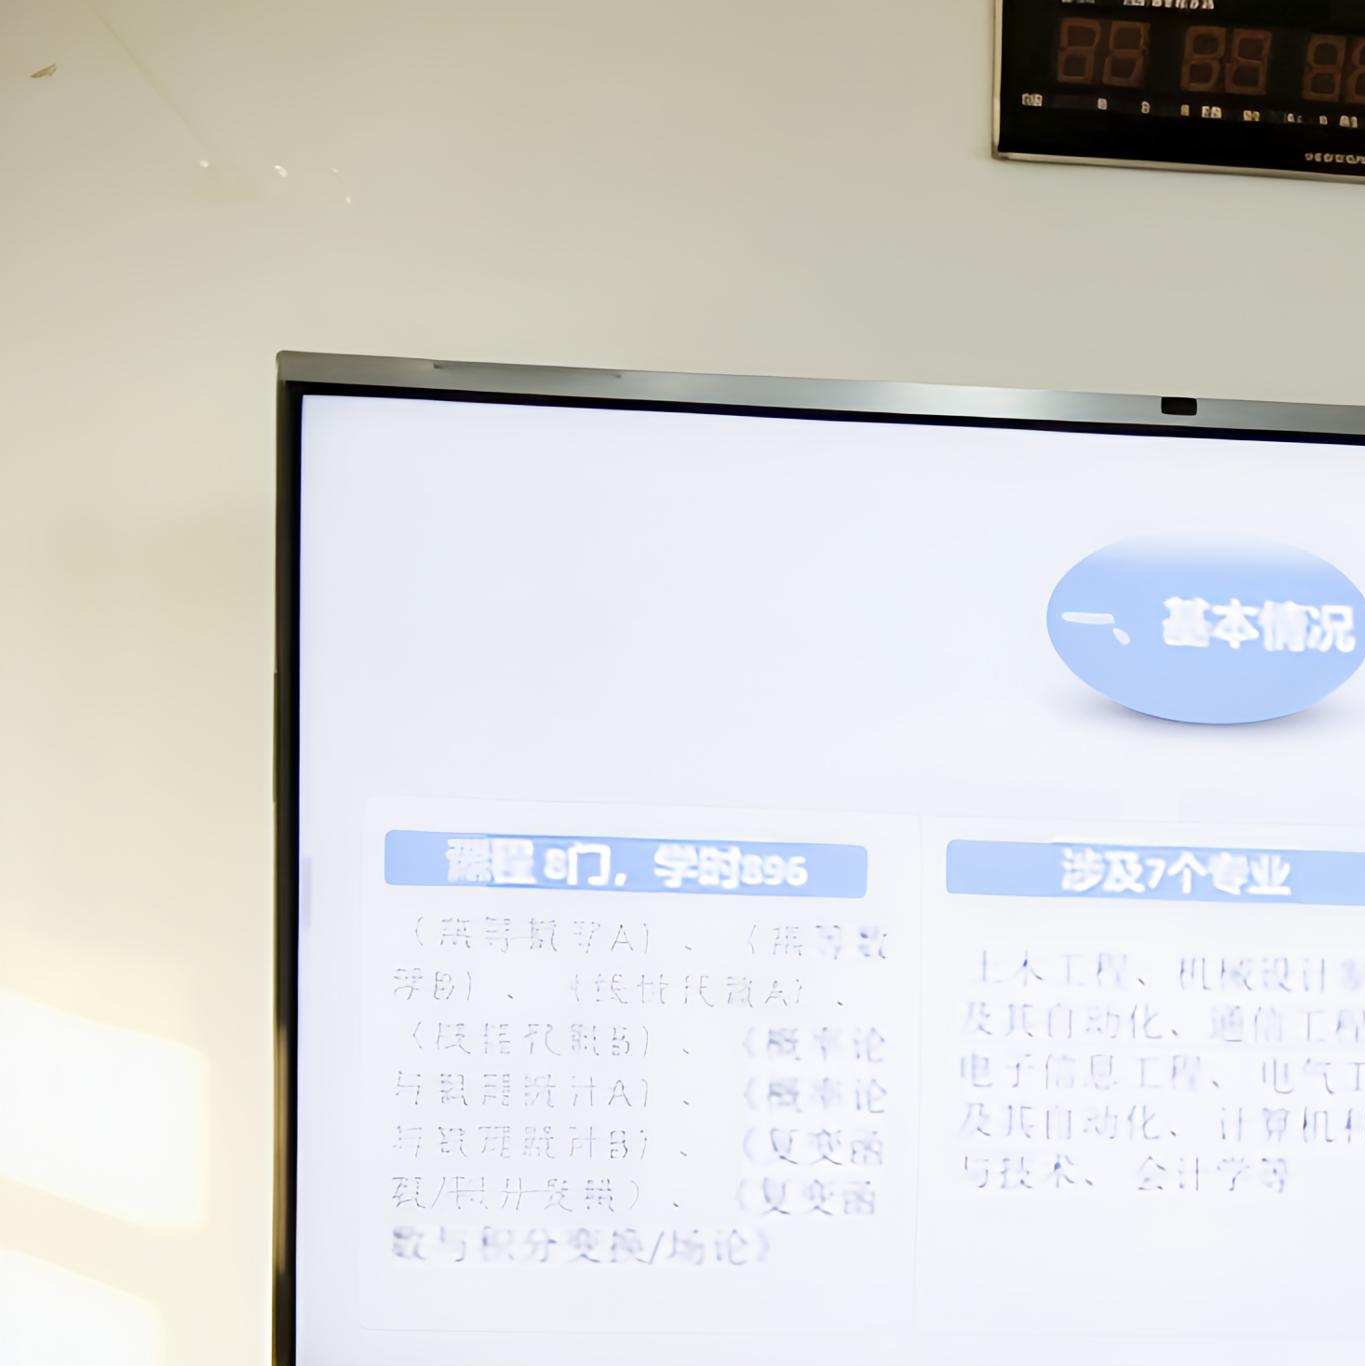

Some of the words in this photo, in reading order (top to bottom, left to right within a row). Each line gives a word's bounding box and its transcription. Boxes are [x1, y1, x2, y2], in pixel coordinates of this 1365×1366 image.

[1060, 848, 1291, 895] 涉及7个专业
